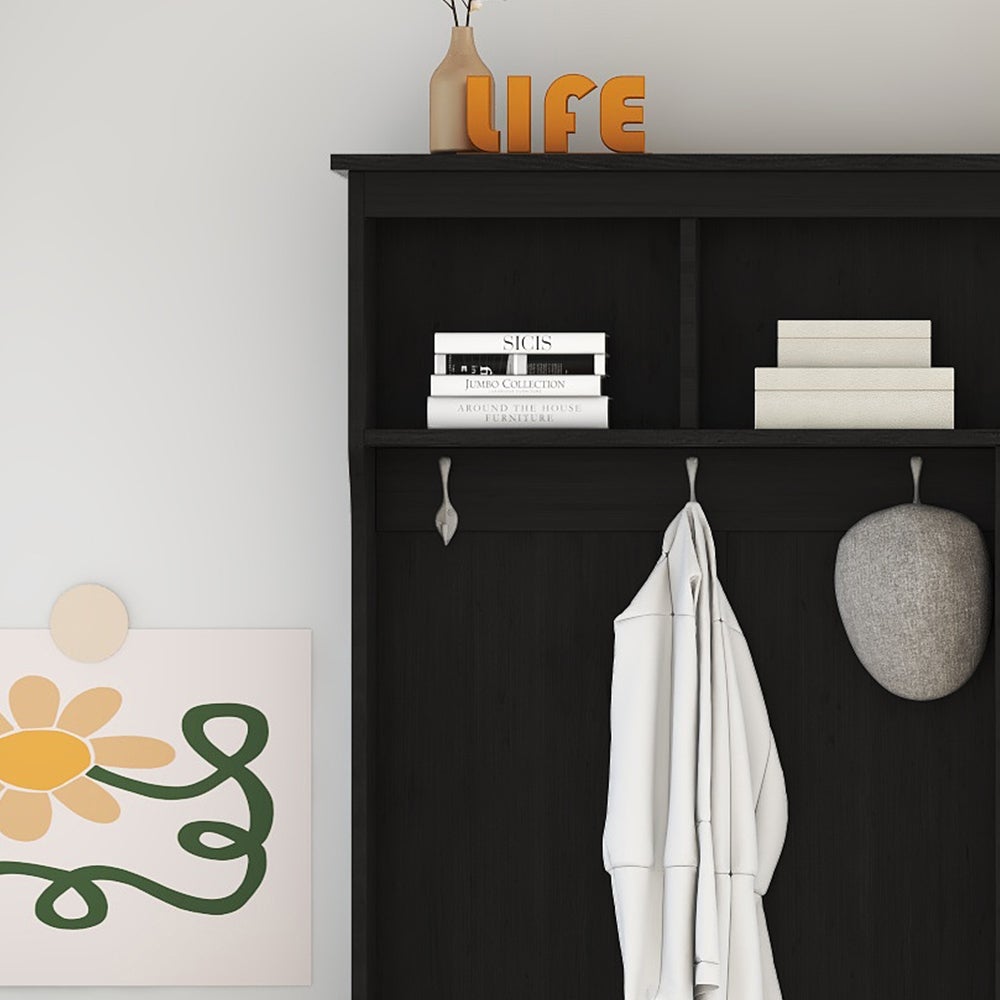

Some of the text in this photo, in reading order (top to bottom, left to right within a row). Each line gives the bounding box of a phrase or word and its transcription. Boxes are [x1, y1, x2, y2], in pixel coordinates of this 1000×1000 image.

[466, 74, 645, 153] LIFE
[503, 335, 552, 351] SICIS
[457, 404, 582, 412] AROUND THE HOUSE
[485, 413, 554, 422] FURNITURE
